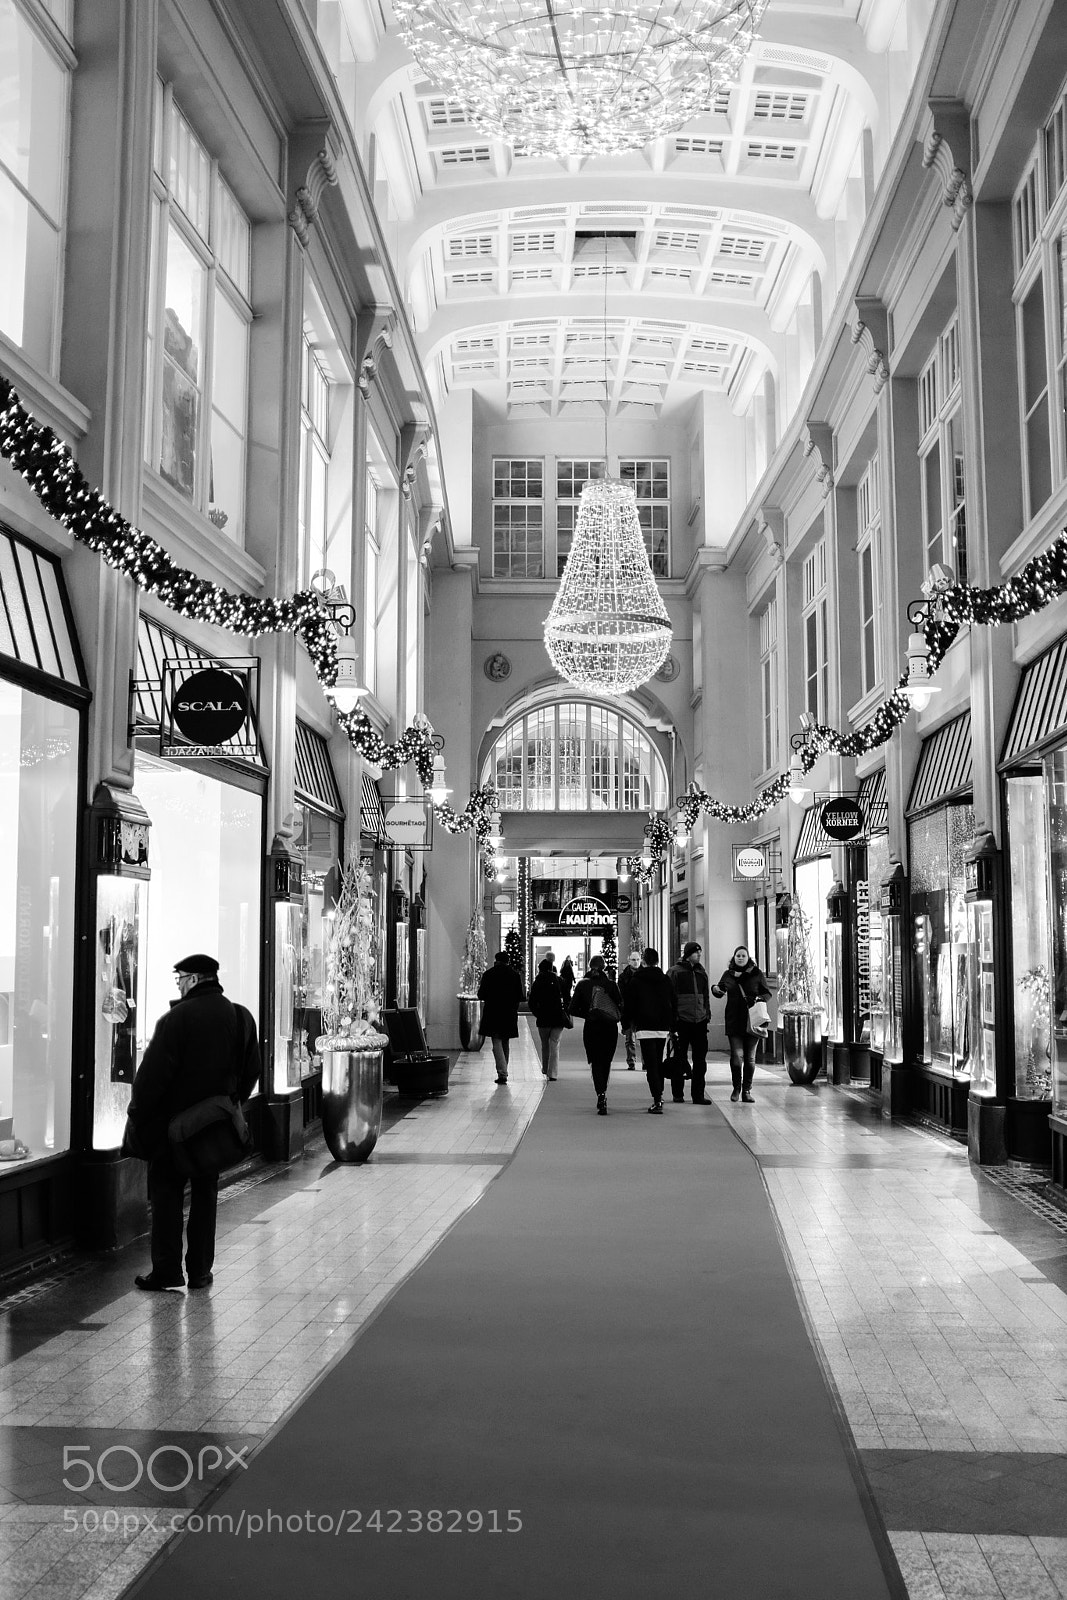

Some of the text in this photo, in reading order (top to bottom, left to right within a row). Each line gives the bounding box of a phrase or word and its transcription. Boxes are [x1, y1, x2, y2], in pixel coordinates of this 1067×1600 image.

[177, 701, 243, 712] SCALA
[825, 811, 859, 820] YELLOW
[825, 818, 859, 827] KORNER
[571, 902, 598, 912] GALERIA
[856, 879, 870, 1018] YELLOWKORNER
